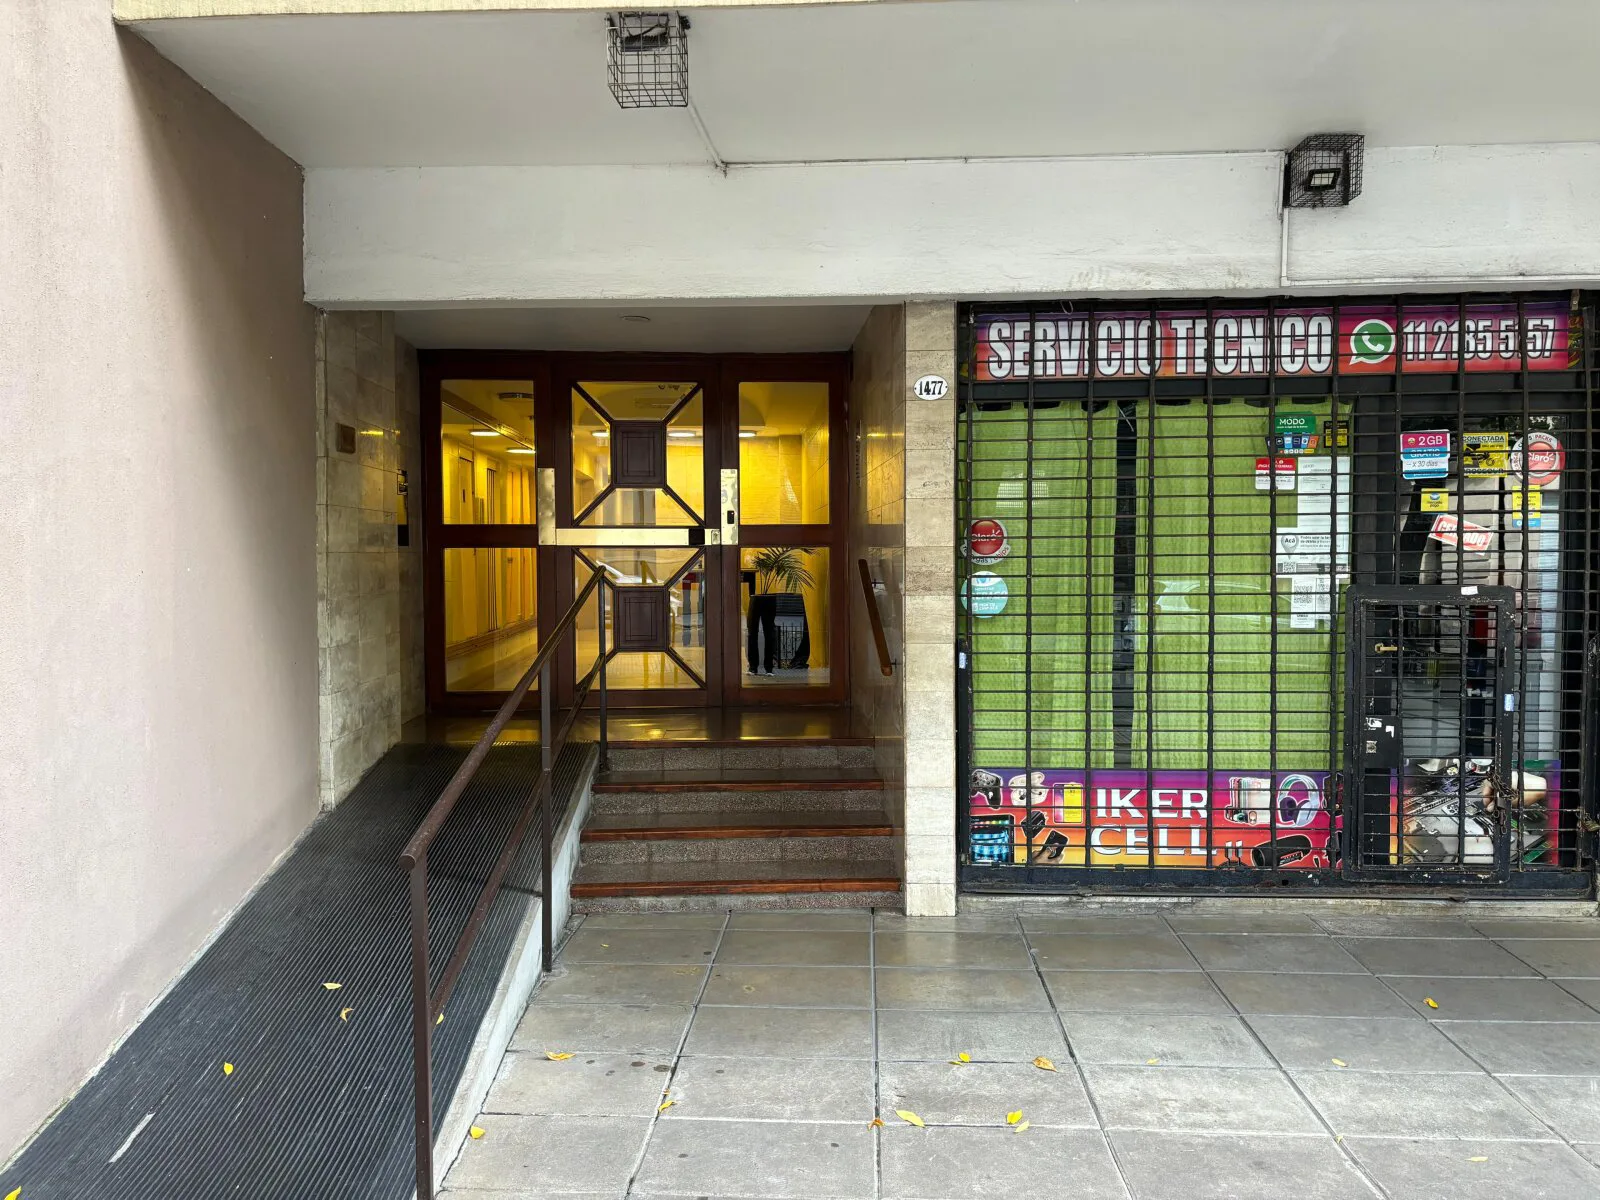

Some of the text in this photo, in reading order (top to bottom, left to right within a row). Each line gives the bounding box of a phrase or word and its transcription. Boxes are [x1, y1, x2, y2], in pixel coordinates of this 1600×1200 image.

[988, 315, 1333, 379] SERVICIO TECNICO
[1402, 320, 1427, 361] 11
[919, 380, 944, 396] 1477
[1418, 435, 1443, 446] 2 GB
[1096, 788, 1208, 818] IKER
[1090, 823, 1217, 855] CELL
